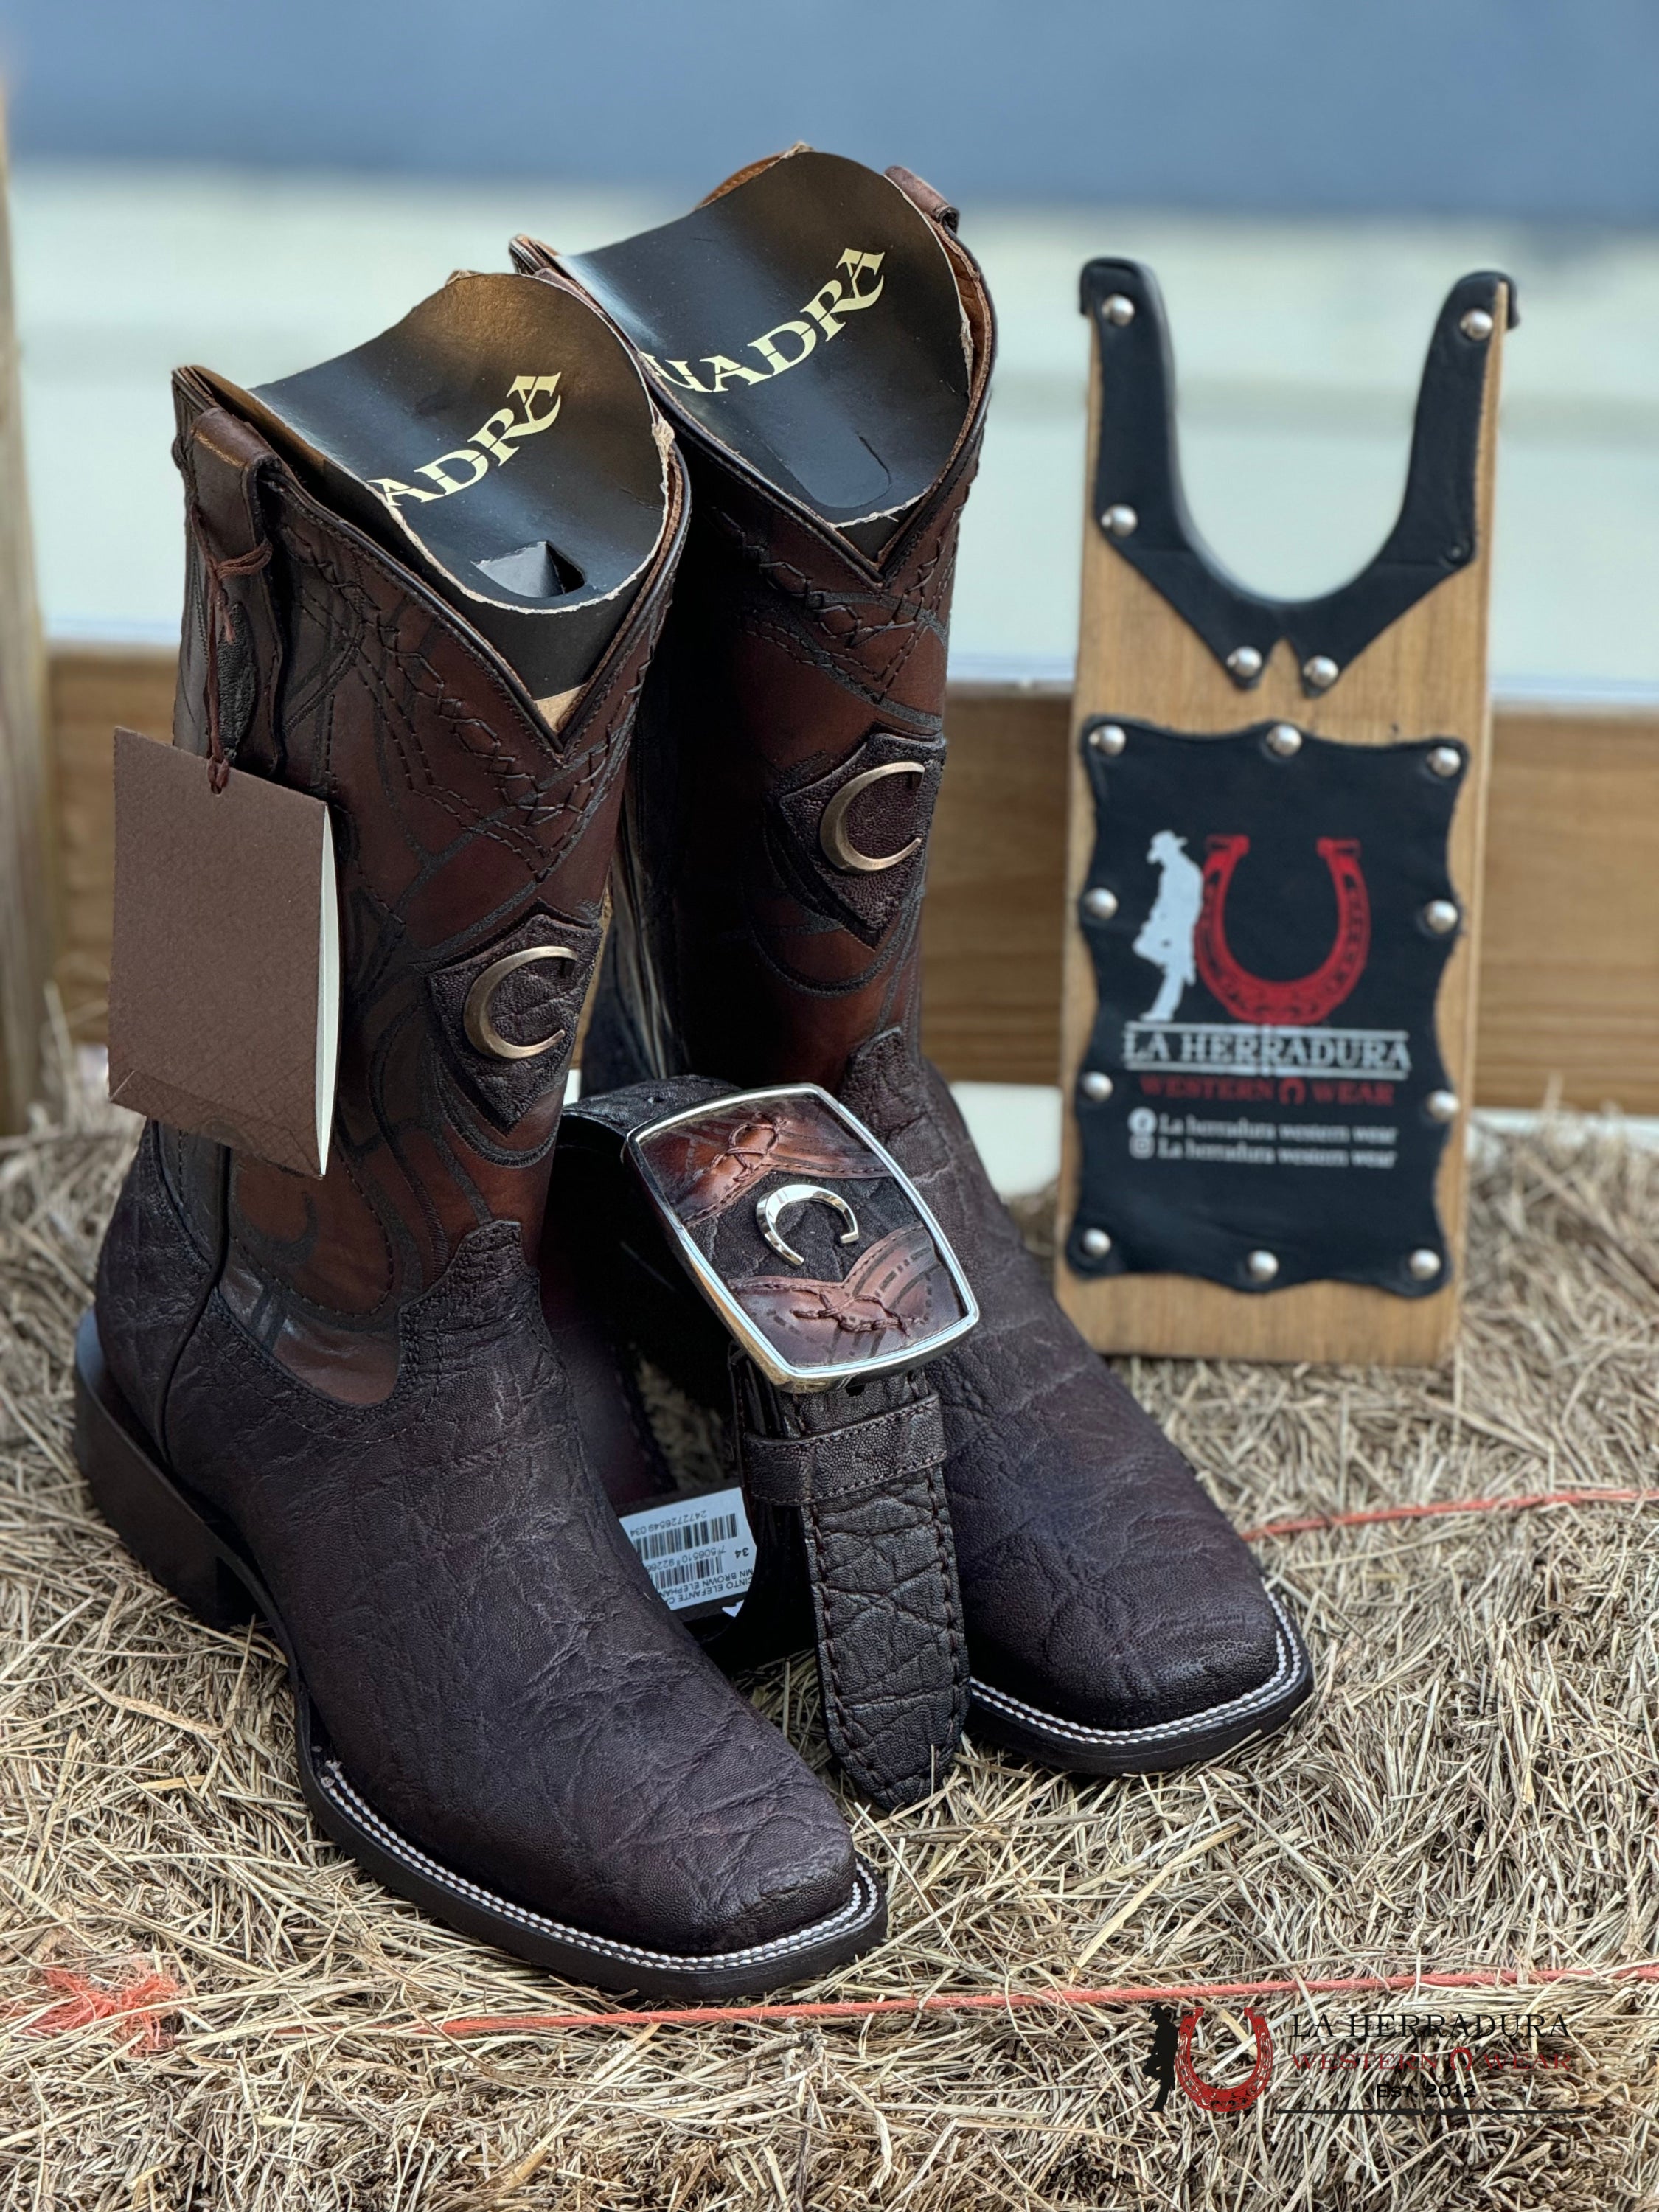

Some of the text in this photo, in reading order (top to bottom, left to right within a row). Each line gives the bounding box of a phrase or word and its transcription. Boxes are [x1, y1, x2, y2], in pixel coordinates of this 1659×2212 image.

[1124, 1032, 1411, 1071] LA HERRADURA
[1140, 1074, 1394, 1105] WESTERN WEAR
[1158, 1113, 1184, 1135] La
[1352, 1126, 1399, 1144] wear
[1158, 1136, 1183, 1159] La
[1351, 1150, 1397, 1169] wear
[630, 1510, 707, 1537] 2472726549 034
[682, 1548, 717, 1564] 506510
[734, 1547, 750, 1559] 34
[702, 1571, 737, 1587] BROWN
[678, 1584, 723, 1603] ELEFANTE
